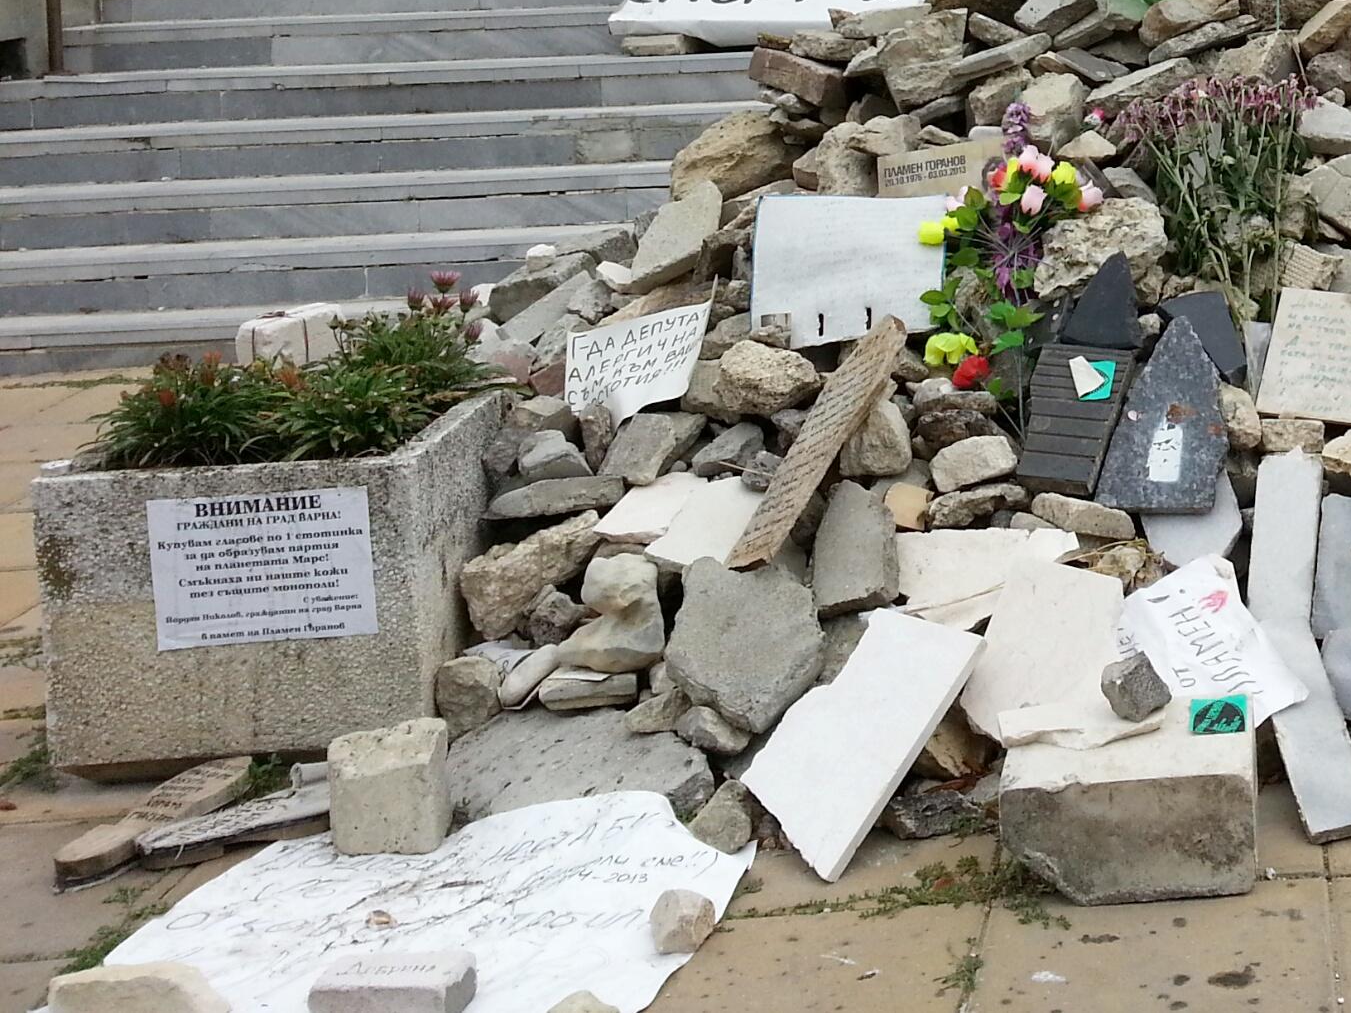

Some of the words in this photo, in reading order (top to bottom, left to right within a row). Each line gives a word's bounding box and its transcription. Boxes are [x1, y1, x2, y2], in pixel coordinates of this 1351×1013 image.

[884, 163, 923, 178] ПЛАМЕН
[925, 155, 966, 171] ГОРАНОВ
[195, 495, 322, 517] ВНИМАНИЕ
[177, 518, 243, 531] ГРАЖДАНИ
[247, 516, 262, 526] НА
[266, 513, 295, 524] ГРАД
[299, 510, 341, 522] ВАРНА!
[158, 539, 212, 551] Купувам
[215, 534, 263, 546] гласове
[267, 535, 282, 543] по
[286, 532, 291, 540] 1
[295, 527, 363, 540] стотинка
[184, 553, 197, 561] за
[200, 551, 215, 561] да
[218, 546, 285, 559] образувам
[288, 541, 339, 554] партия
[196, 563, 211, 571] на
[214, 559, 289, 571] планетата
[293, 554, 329, 565] Марс!
[178, 575, 243, 587] Смъкнаха
[246, 574, 262, 582] ни
[314, 566, 349, 577] кожи
[217, 585, 269, 598] същите
[273, 579, 340, 591] монополи!
